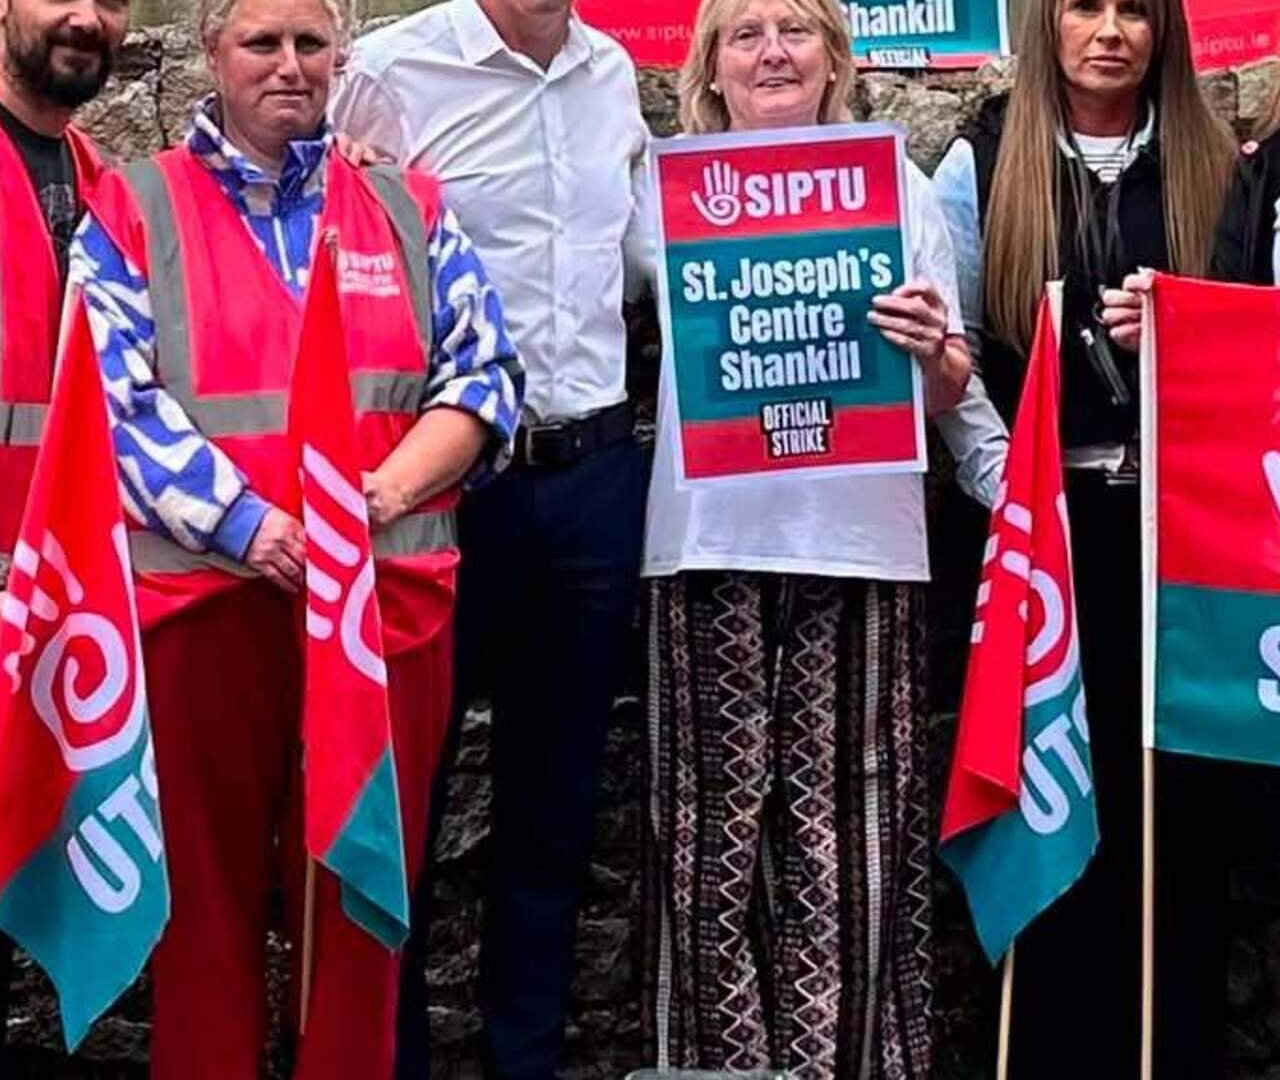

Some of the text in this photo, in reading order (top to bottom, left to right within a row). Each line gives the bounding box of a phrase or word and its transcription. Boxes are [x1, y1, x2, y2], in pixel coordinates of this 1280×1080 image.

[743, 166, 867, 217] SIPTU
[682, 248, 893, 303] St. Joseph's
[729, 301, 845, 345] Centre
[720, 341, 861, 392] Shankill
[763, 400, 831, 431] OFFICIAL
[771, 427, 826, 457] STRIKE
